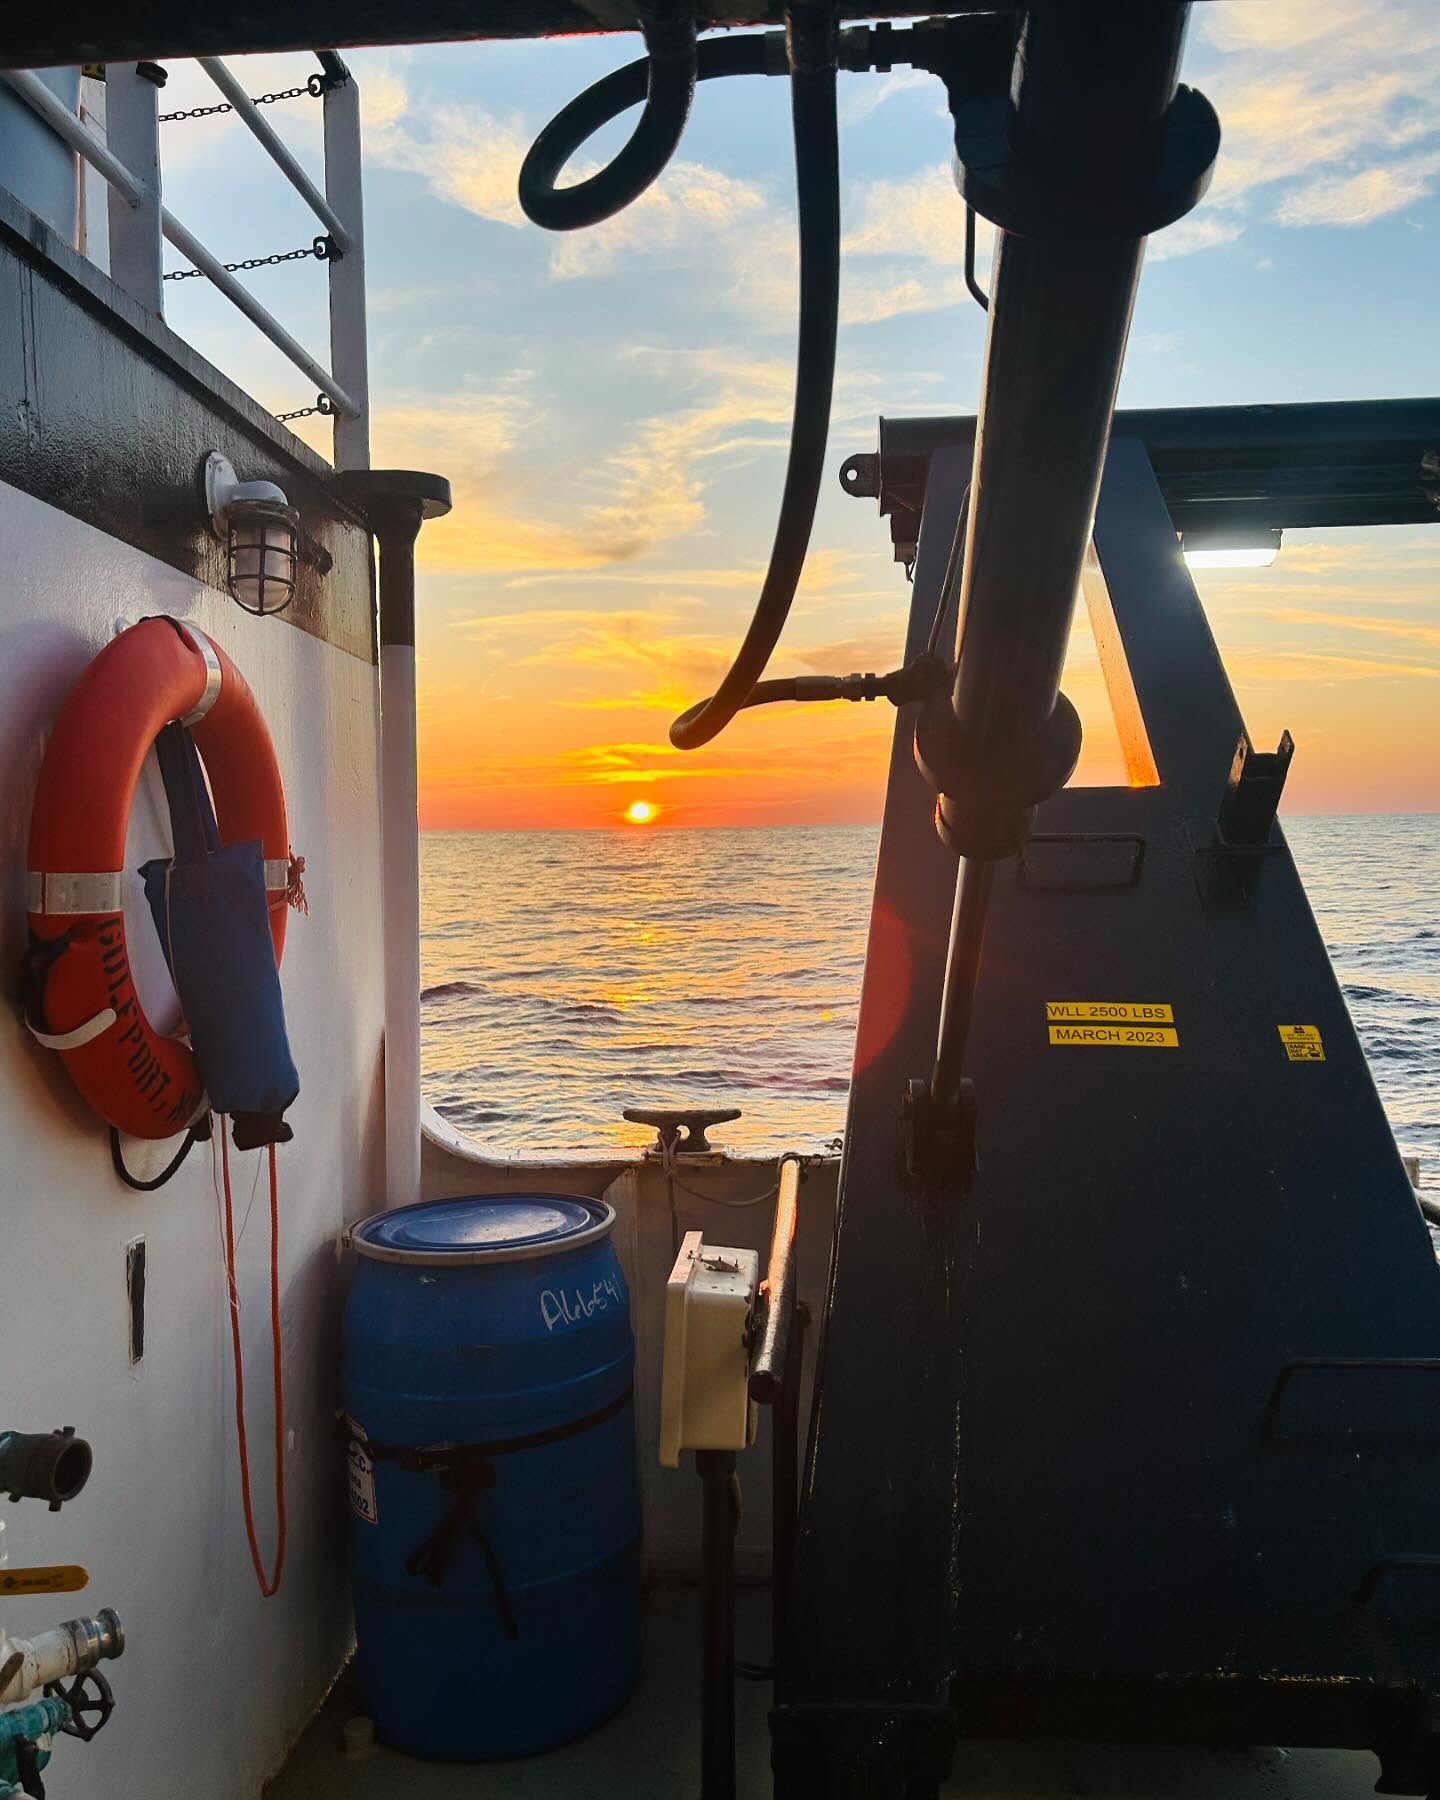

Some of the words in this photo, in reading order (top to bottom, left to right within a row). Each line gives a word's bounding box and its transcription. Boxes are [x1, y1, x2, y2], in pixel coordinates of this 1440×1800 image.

[1049, 1006, 1086, 1017] WLL
[1089, 1006, 1128, 1018] 2500
[1132, 1007, 1166, 1019] LBS
[1056, 1029, 1120, 1041] MARCH
[1125, 1030, 1165, 1043] 2023
